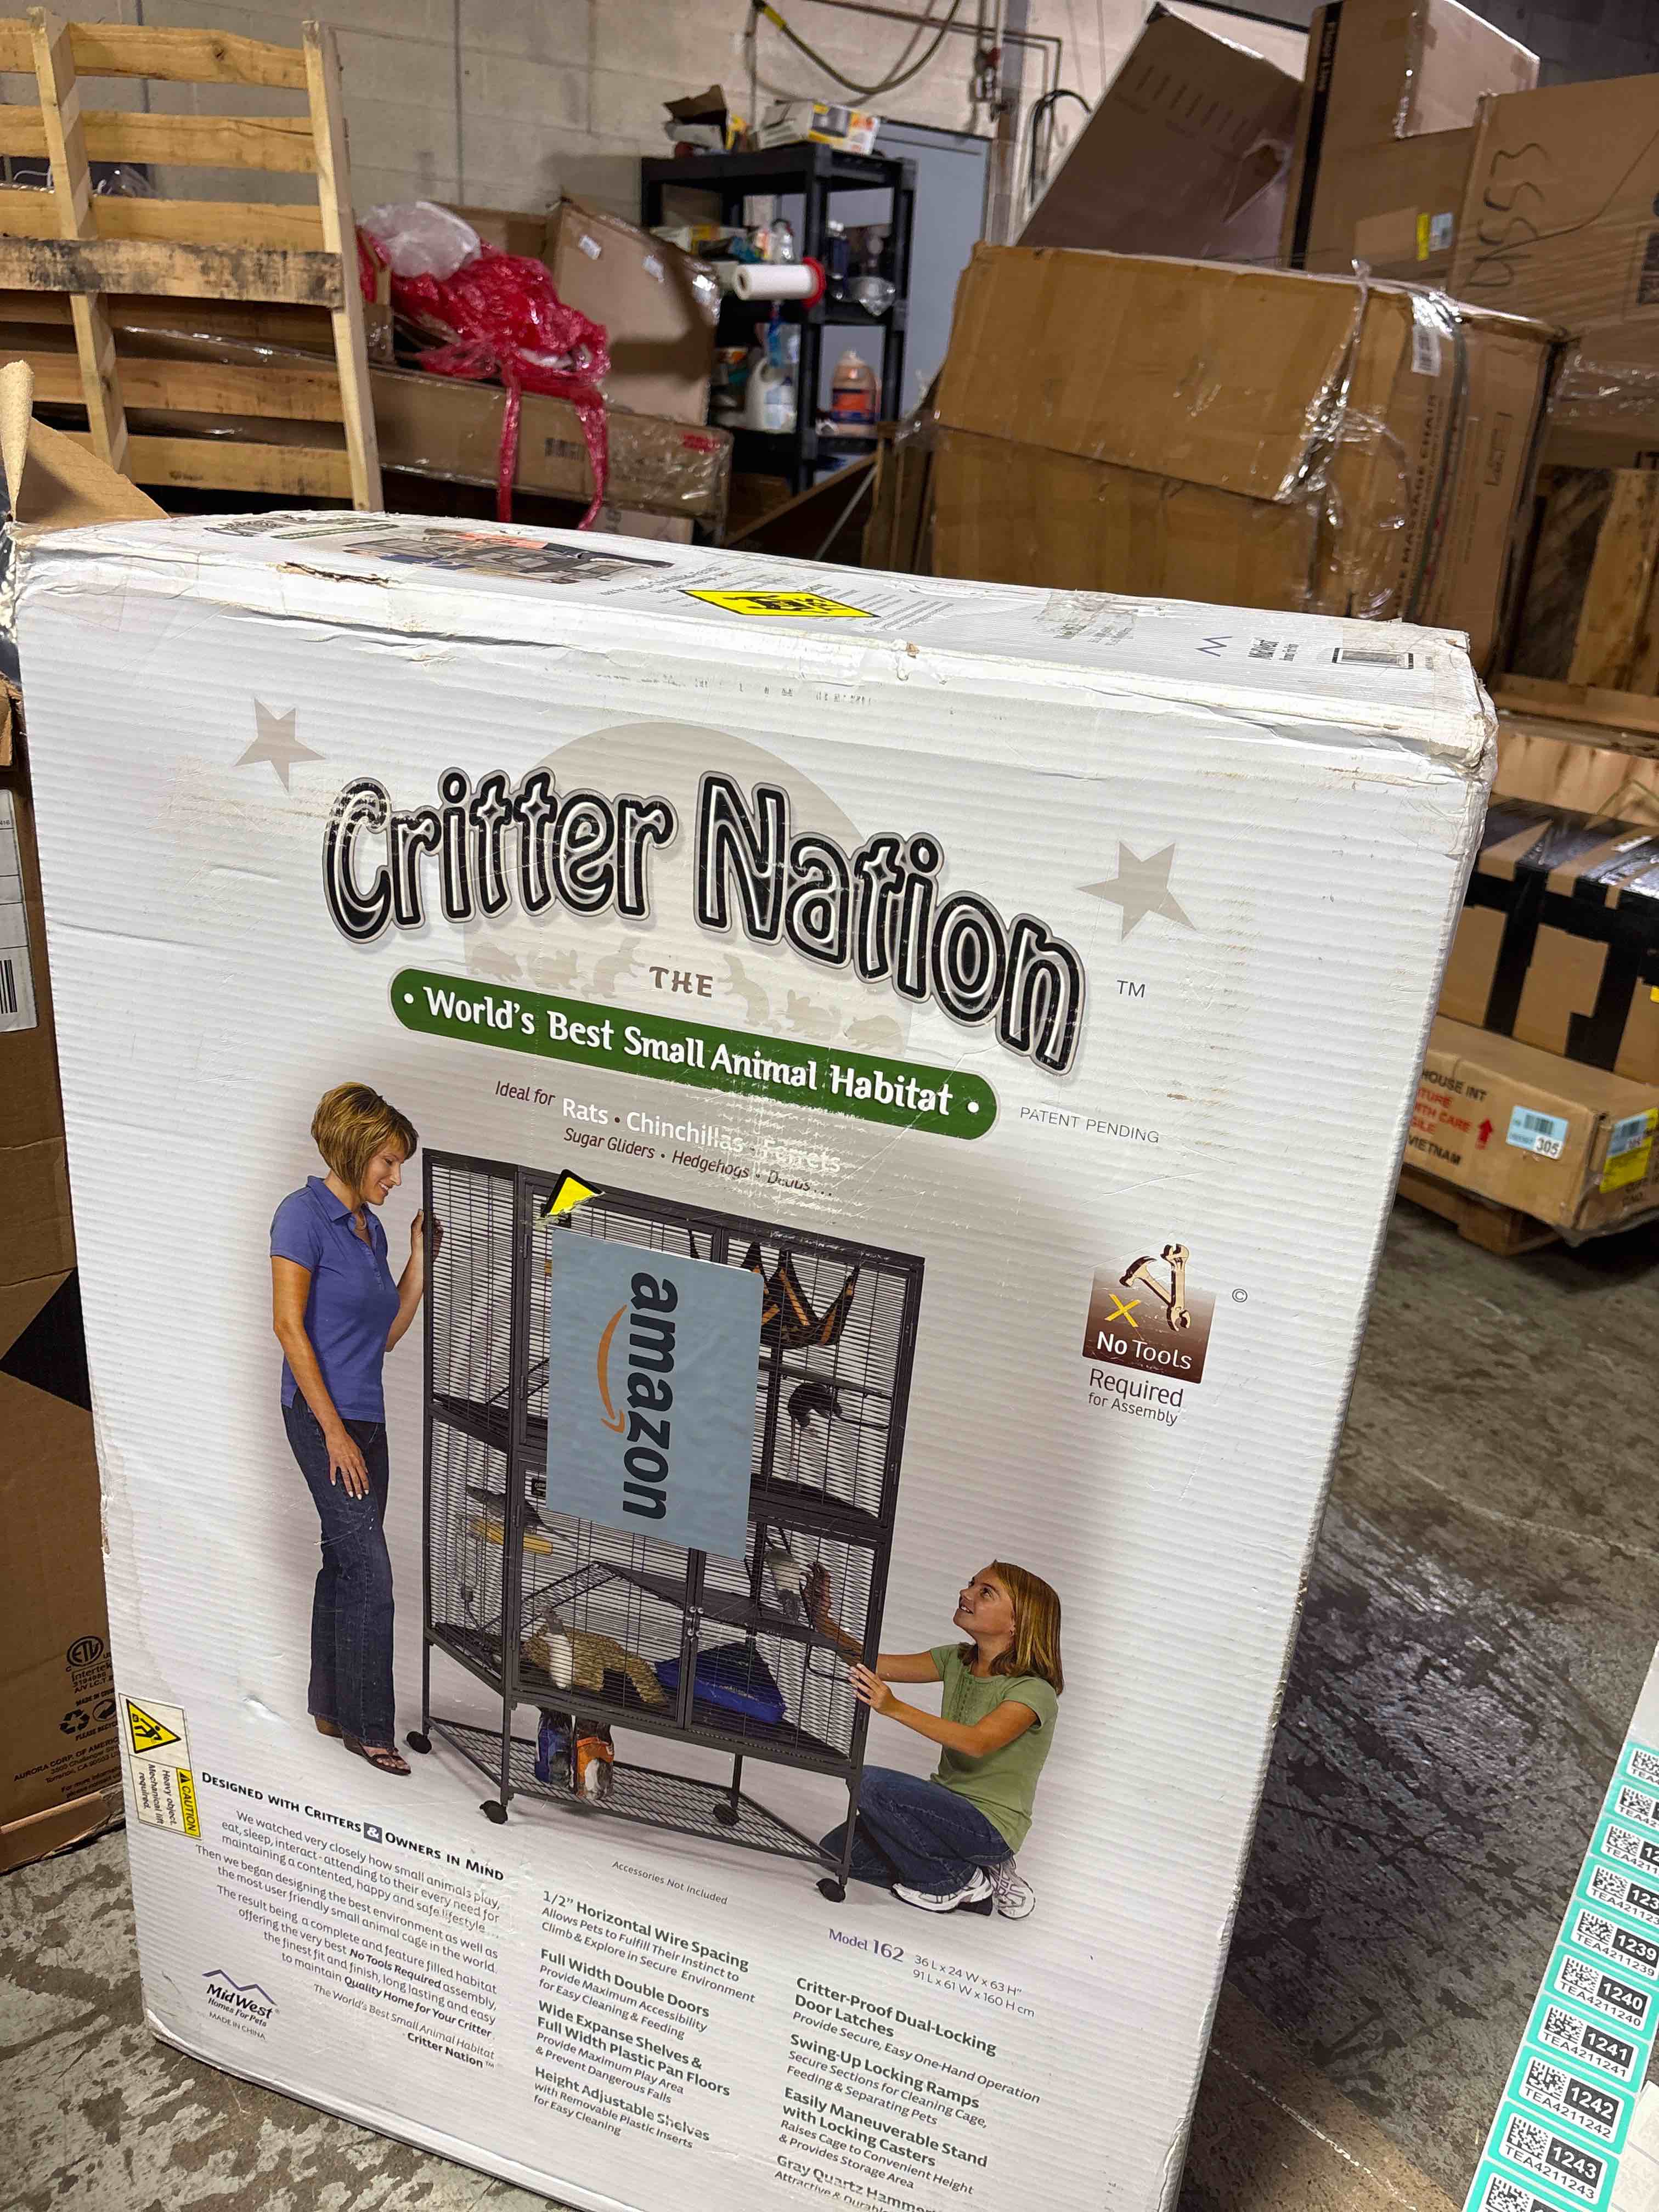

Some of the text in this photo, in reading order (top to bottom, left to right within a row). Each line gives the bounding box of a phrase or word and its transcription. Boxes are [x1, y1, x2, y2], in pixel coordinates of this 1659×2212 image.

[323, 767, 1086, 1075] Critter Nation
[650, 966, 713, 998] THE
[1117, 980, 1146, 998] TM
[423, 986, 952, 1116] World's Best Small Animal Habitat
[495, 1080, 531, 1102] Ideal
[534, 1089, 556, 1107] for
[562, 1098, 608, 1125] Rats
[627, 1111, 744, 1153] Chinchillas
[1020, 1107, 1159, 1143] PATENT PENDING
[564, 1128, 605, 1148] Sugar
[607, 1137, 655, 1159] Gliders
[672, 1150, 749, 1180] Hedgehogs
[1537, 1138, 1560, 1155] 305
[1097, 1331, 1193, 1370] No Tools
[623, 1272, 678, 1520] amazon
[1089, 1368, 1184, 1407] Required
[1088, 1392, 1178, 1427] for Assembly
[14, 1764, 48, 1781] AURORA
[76, 1748, 87, 1757] OF
[162, 1769, 172, 1796] Heavy
[148, 1764, 164, 1824] Mechanical lift
[182, 1786, 196, 1831] CAUTION
[365, 1825, 381, 1841] &
[612, 1861, 728, 1905] Accessories Not Included
[577, 1901, 651, 1937] Horizontal
[655, 1928, 689, 1949] Wire
[691, 1942, 749, 1973] Spacing
[830, 1928, 904, 1962] Model 162
[1576, 1934, 1655, 1976] TEA4211239
[1617, 1934, 1657, 1961] 1239
[239, 1909, 496, 2011] offering the very best No Tools Required assembly,
[915, 1955, 929, 1967] 36
[932, 1960, 937, 1970] L
[948, 1966, 962, 1978] 24
[966, 1971, 979, 1983] W
[981, 1979, 987, 1987] x
[990, 1981, 1005, 1991] 63
[207, 1984, 273, 2019] MidWest
[541, 1948, 709, 2017] Full Width Double Doors
[913, 1970, 924, 1980] 91
[927, 1973, 933, 1983] L
[944, 1980, 955, 1990] 61
[959, 1984, 972, 1995] W
[984, 1993, 1003, 2006] 160
[1006, 1999, 1015, 2011] H
[1017, 2006, 1034, 2017] cm
[1603, 1982, 1643, 2011] 1240
[208, 1997, 267, 2027] Homes for Pets
[210, 2011, 266, 2040] MADE IN CHINA
[314, 1984, 331, 1997] The
[369, 2005, 390, 2019] Best
[391, 2013, 419, 2030] Small
[419, 2025, 455, 2044] Animal
[456, 2038, 494, 2059] Habitat
[795, 1994, 894, 2037] Door Latches
[797, 1978, 997, 2057] Critter-Proof Dual-Locking
[1560, 1982, 1641, 2027] TEA4211240
[408, 2033, 443, 2052] Critter
[445, 2046, 483, 2068] Nation
[538, 2016, 730, 2096] Full Width Plastic Pan Floors
[539, 2000, 702, 2069] Wide Expanse Shelves &
[1543, 2032, 1627, 2077] TEA4211241
[1587, 2033, 1628, 2061] 1241
[791, 2034, 979, 2108] Swing-Up Locking Ramps
[793, 2011, 1040, 2103] Provide Secure, Easy One-Hand Operation
[1525, 2087, 1611, 2138] TEA4211242
[1571, 2087, 1614, 2119] 1242
[785, 2087, 988, 2168] Easily Maneuverable Stand
[1505, 2145, 1594, 2199] TEA4211243
[1553, 2146, 1597, 2179] 1243
